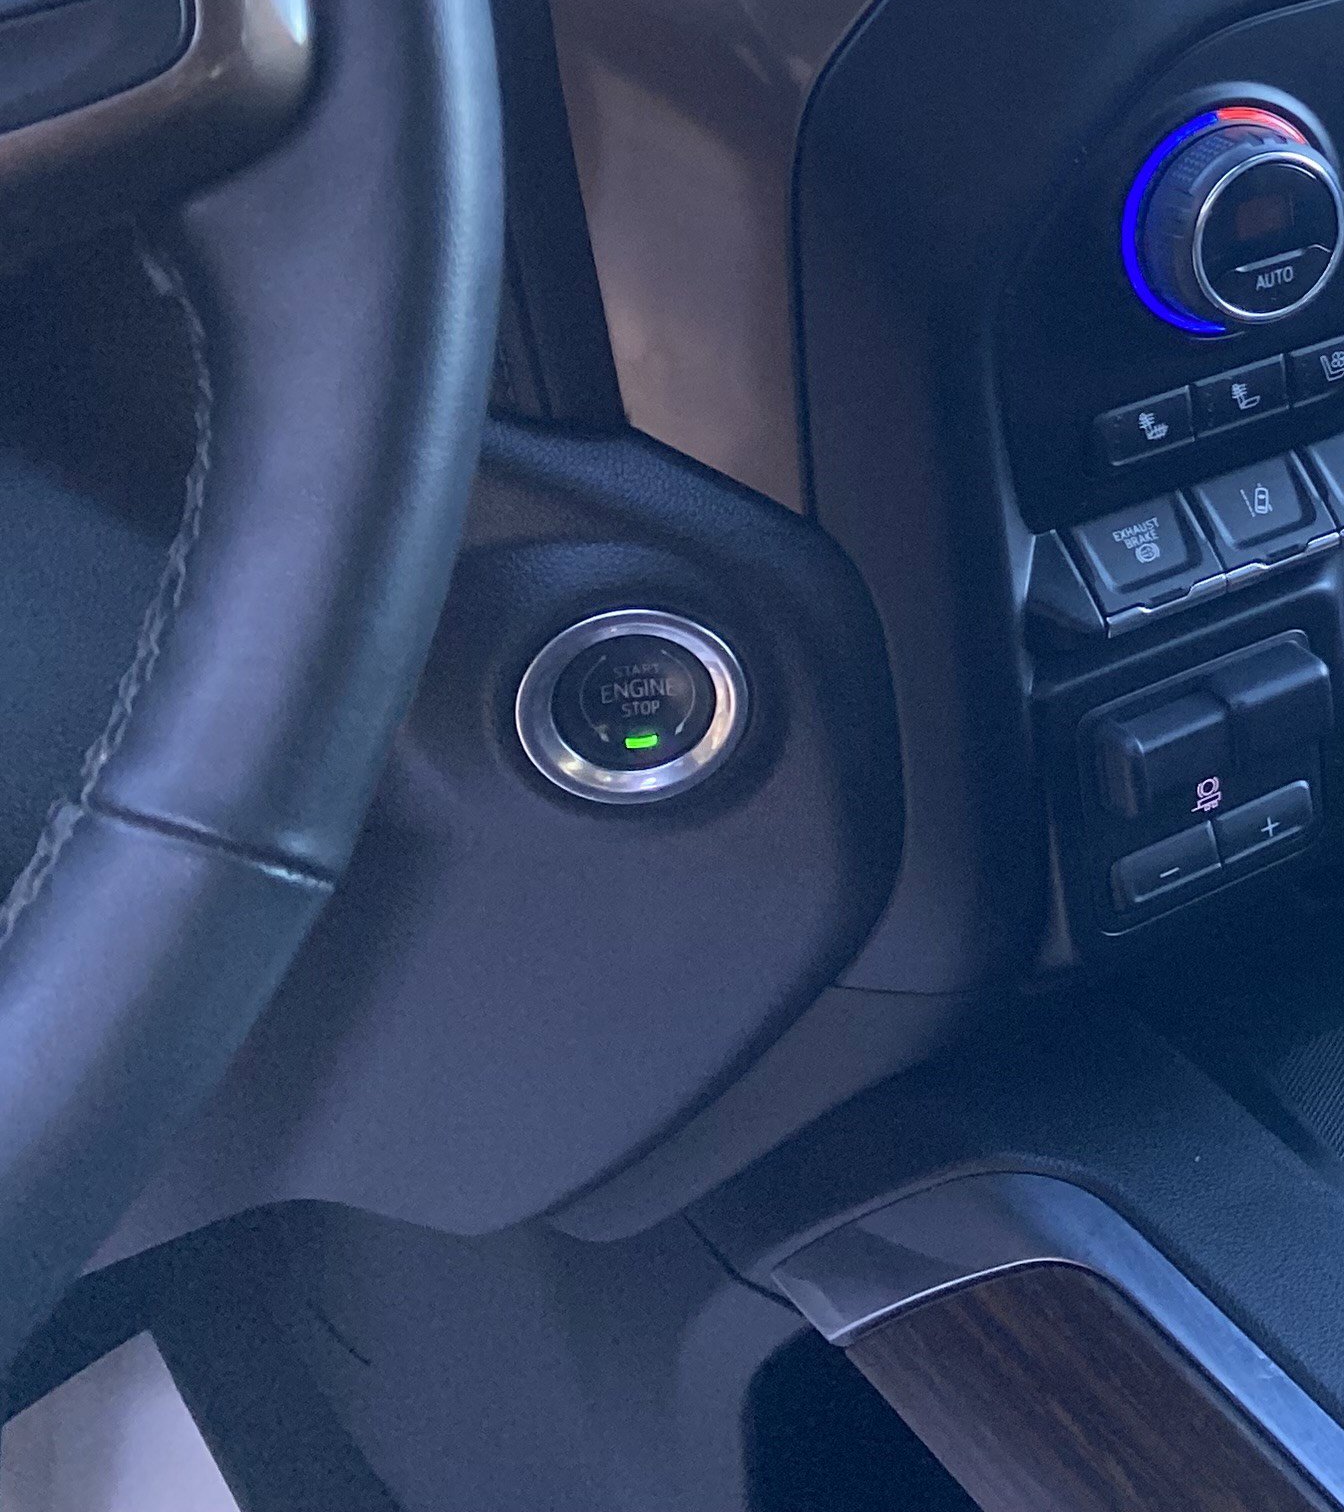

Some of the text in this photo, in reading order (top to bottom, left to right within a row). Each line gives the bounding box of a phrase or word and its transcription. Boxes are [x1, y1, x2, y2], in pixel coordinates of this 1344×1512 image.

[1255, 266, 1294, 291] AUTO
[1112, 517, 1160, 542] EXHAUST
[1124, 529, 1160, 550] BRAKE
[600, 677, 677, 705] ENGINE
[621, 700, 660, 718] STOP
